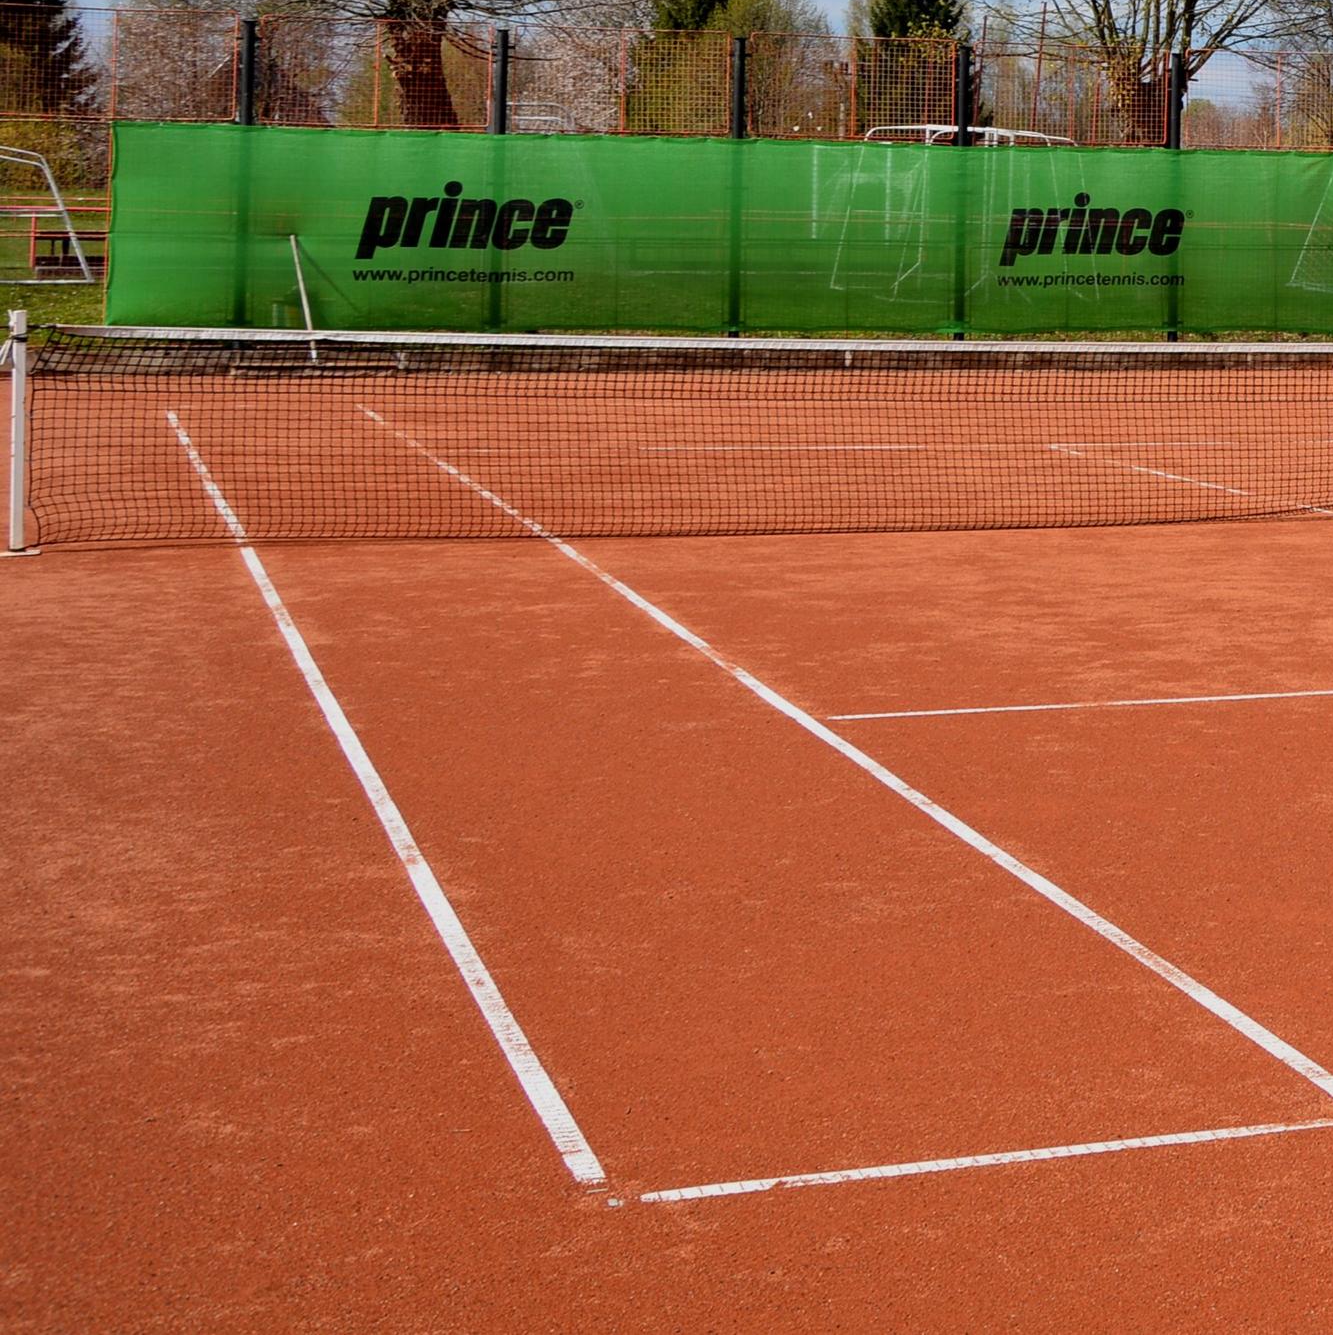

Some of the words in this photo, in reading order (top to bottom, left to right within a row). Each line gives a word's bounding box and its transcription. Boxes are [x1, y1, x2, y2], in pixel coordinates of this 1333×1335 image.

[355, 180, 574, 259] prince
[999, 192, 1185, 266] prince
[353, 266, 575, 284] www.princetennis.com
[998, 271, 1185, 289] www.princetennis.com
